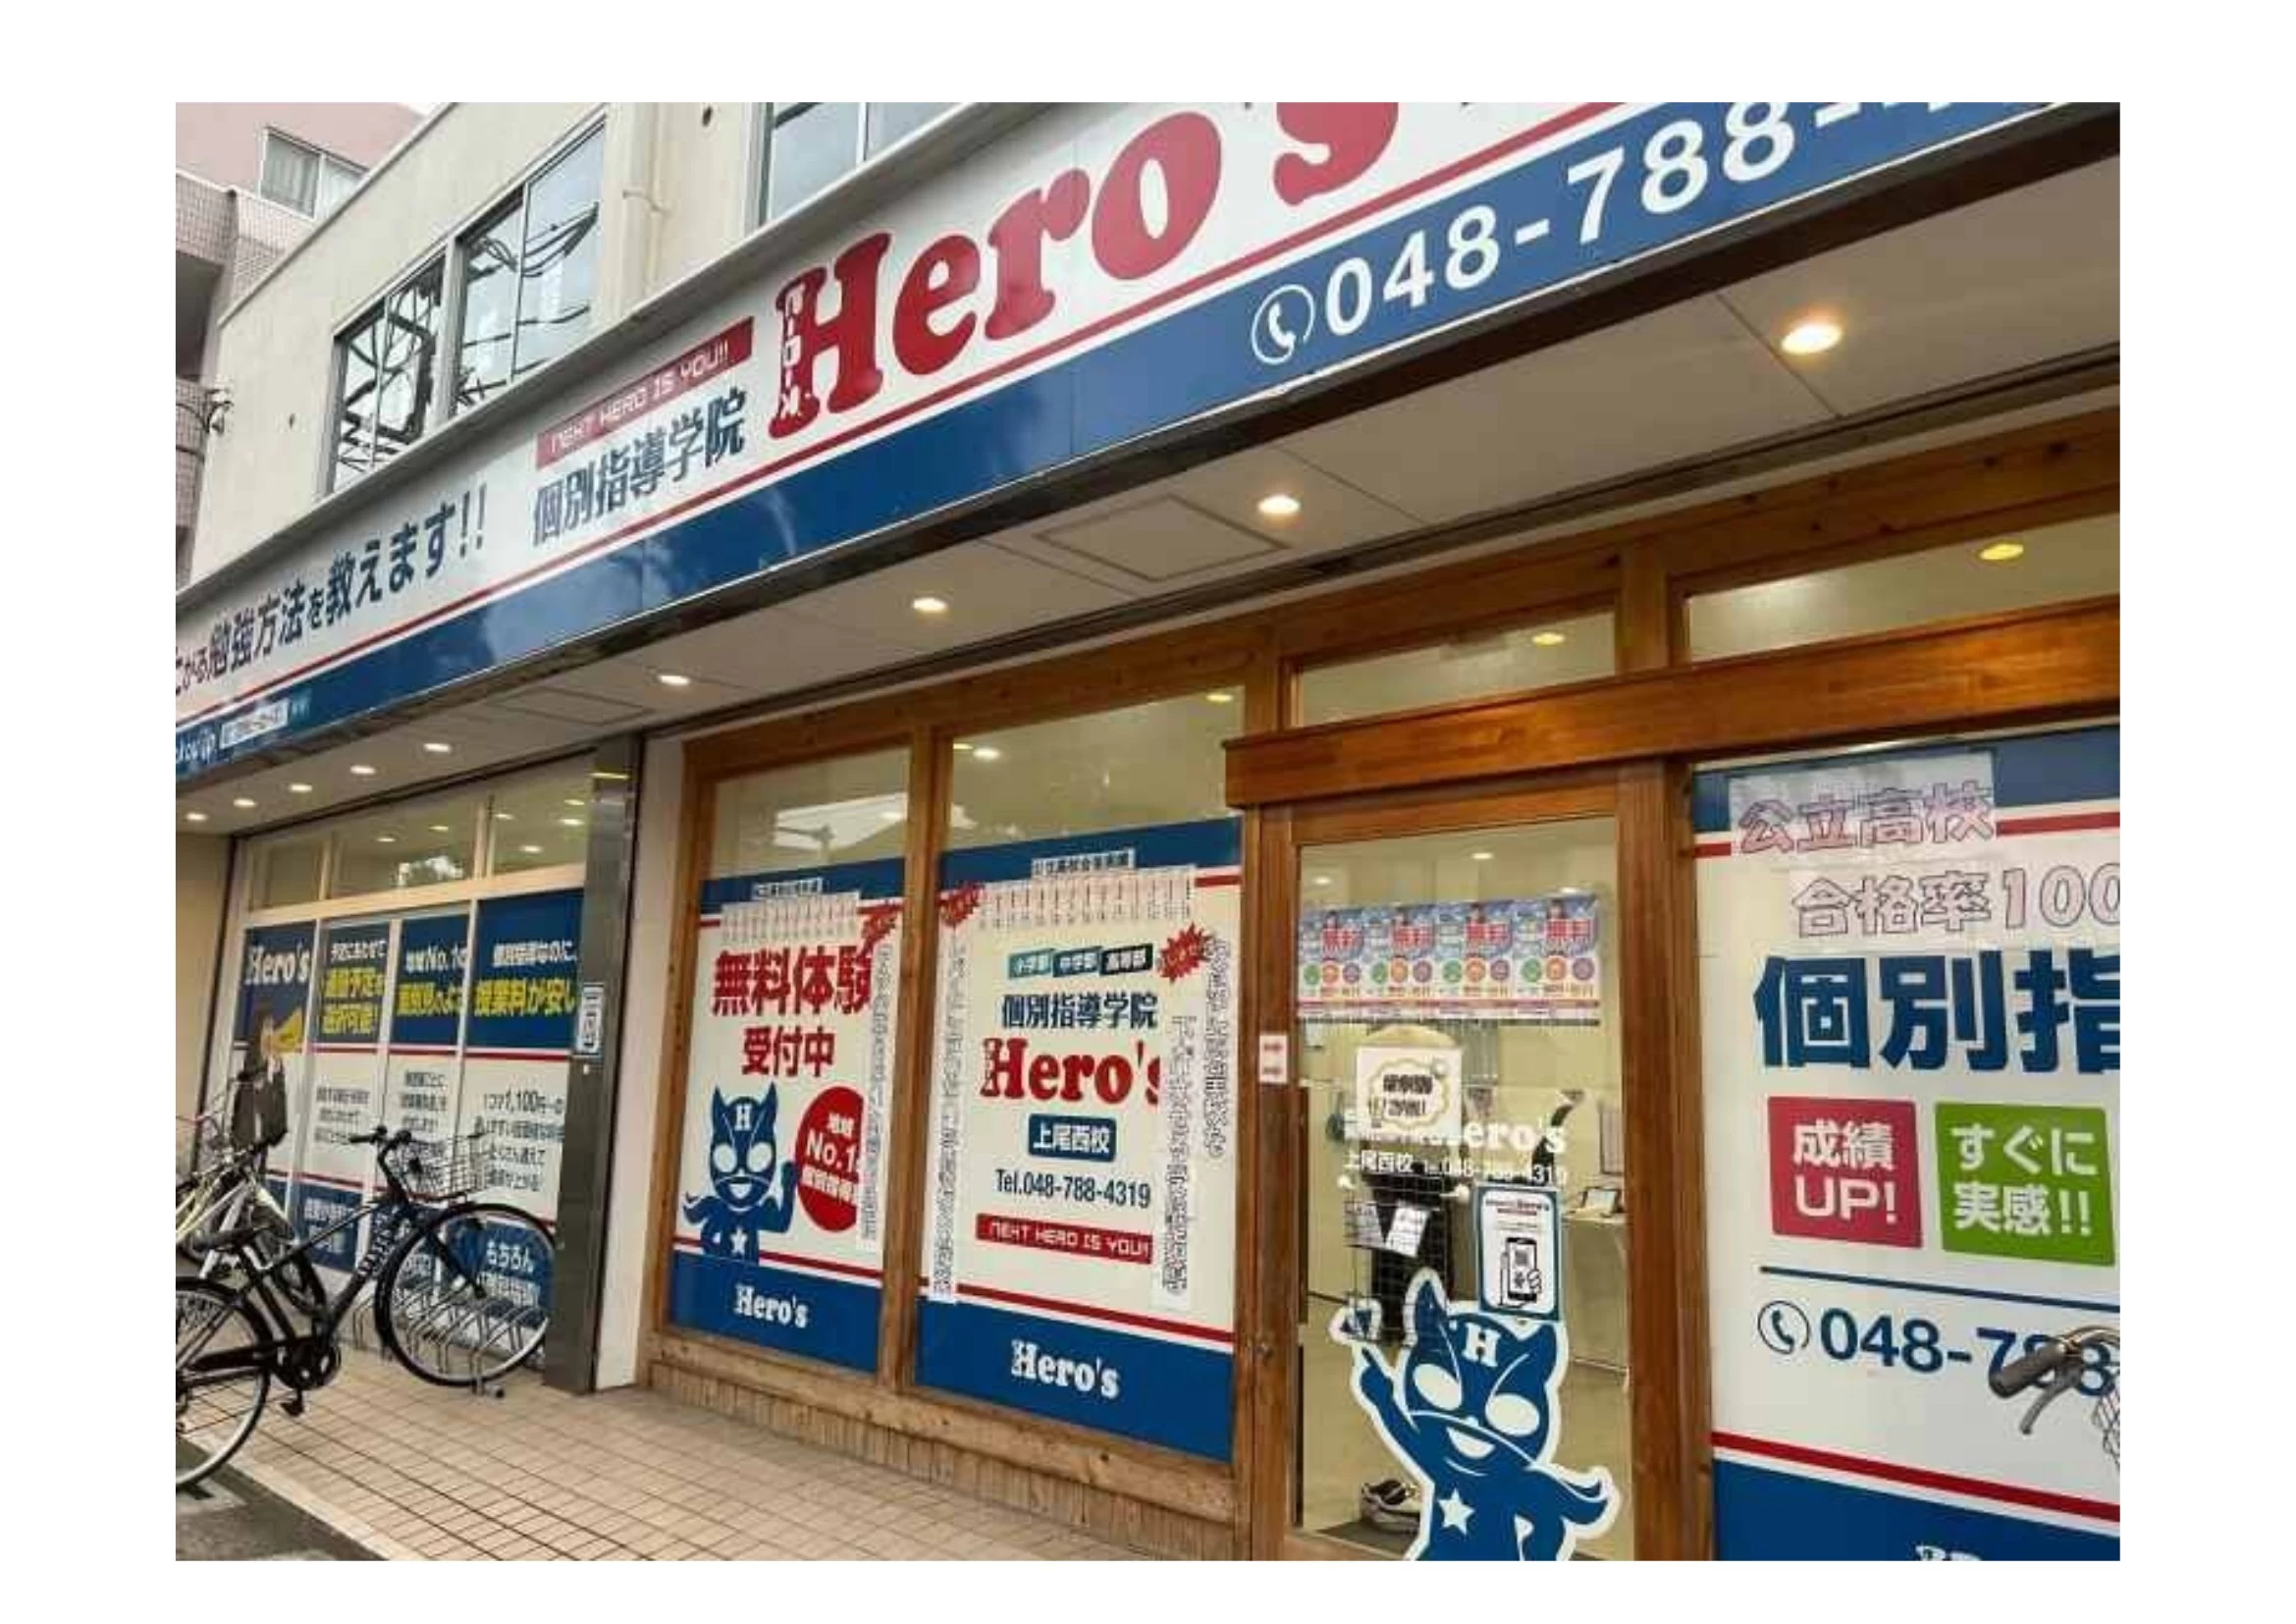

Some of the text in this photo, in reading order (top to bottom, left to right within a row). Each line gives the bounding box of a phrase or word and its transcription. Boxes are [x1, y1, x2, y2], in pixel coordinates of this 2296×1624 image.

[1324, 102, 1953, 337] 048-788-
[769, 102, 1399, 439] Heros
[600, 387, 649, 427] HERO
[653, 369, 675, 400] IS
[679, 338, 730, 387] YOU!!
[533, 385, 747, 548] 個別指導学院
[1738, 781, 1996, 854] 公立高校
[712, 945, 872, 1016] 無料体験
[1001, 991, 1159, 1029] 個別指導学院
[1753, 947, 2119, 1074] 個別指
[741, 1025, 835, 1077] 受付中
[736, 1106, 752, 1130] H
[1033, 1122, 1111, 1155] 上尾西校
[805, 1129, 859, 1174] No.1
[1792, 1119, 1896, 1171] 成績
[1951, 1124, 2099, 1177] すぐに
[994, 1167, 1151, 1210] Tel.048-788-4319
[1795, 1177, 1899, 1224] UP!
[1953, 1182, 2092, 1237] 実感!!
[1036, 1227, 1079, 1247] HERO
[1083, 1233, 1101, 1251] IS
[733, 1281, 809, 1329] Hero's
[1011, 1339, 1121, 1400] Hero's
[1463, 1322, 1501, 1368] H
